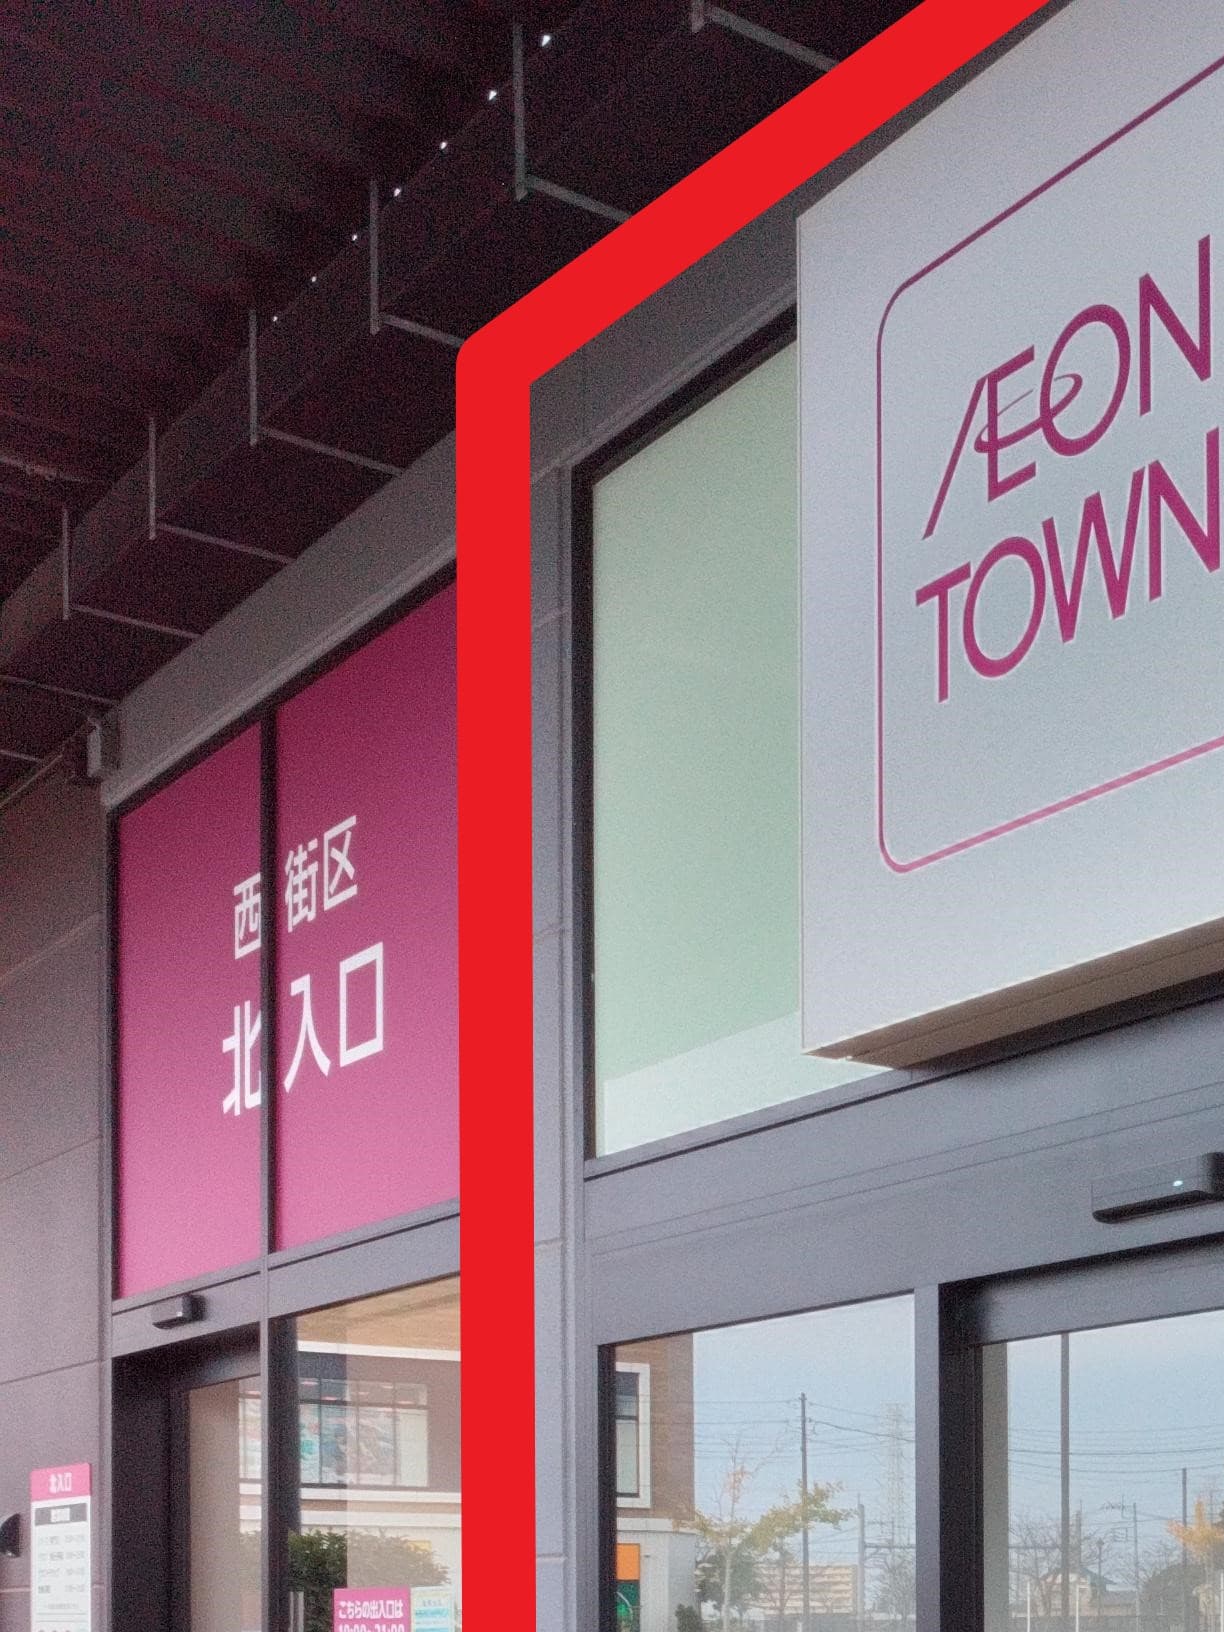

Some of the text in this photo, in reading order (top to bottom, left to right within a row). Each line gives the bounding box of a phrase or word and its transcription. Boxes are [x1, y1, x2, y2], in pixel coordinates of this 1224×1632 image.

[914, 425, 1222, 704] TOWN
[221, 941, 384, 1117] 北入口
[338, 1599, 404, 1619] こちらの出入口は
